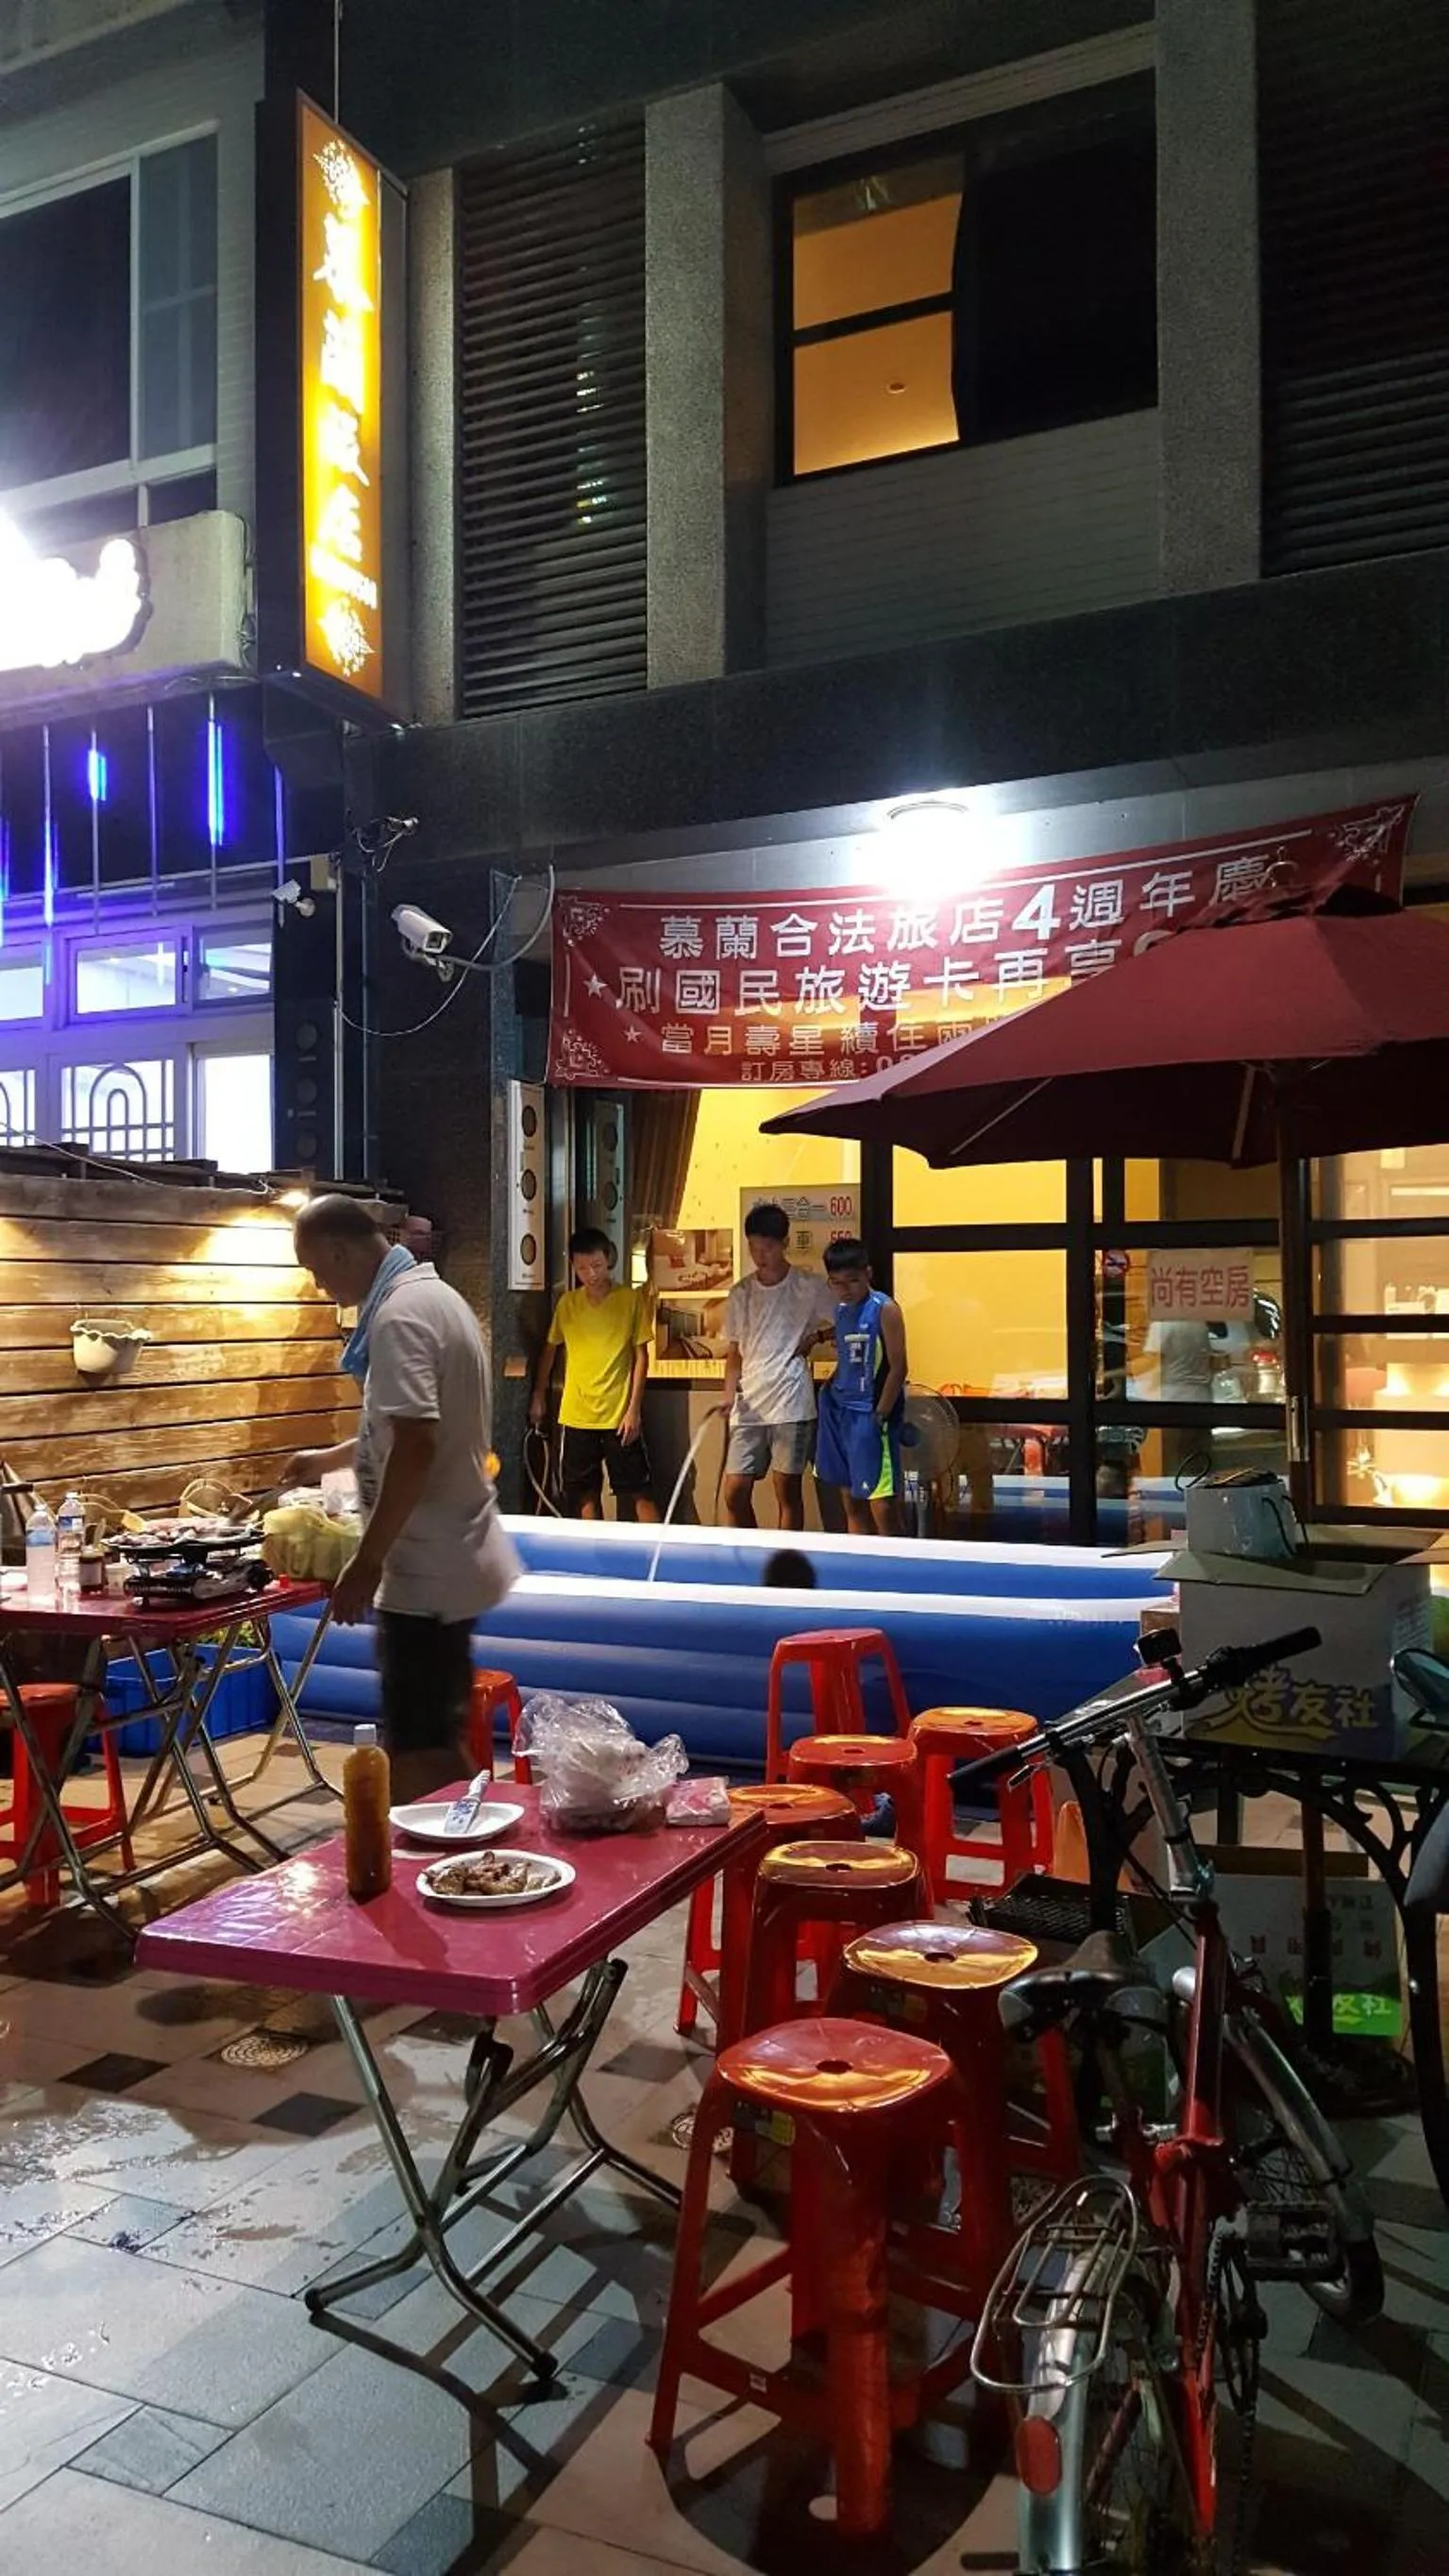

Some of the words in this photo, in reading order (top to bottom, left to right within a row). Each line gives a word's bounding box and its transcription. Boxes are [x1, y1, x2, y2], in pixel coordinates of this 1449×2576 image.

[830, 1195, 853, 1216] 600
[1151, 1265, 1251, 1309] 尚有空房
